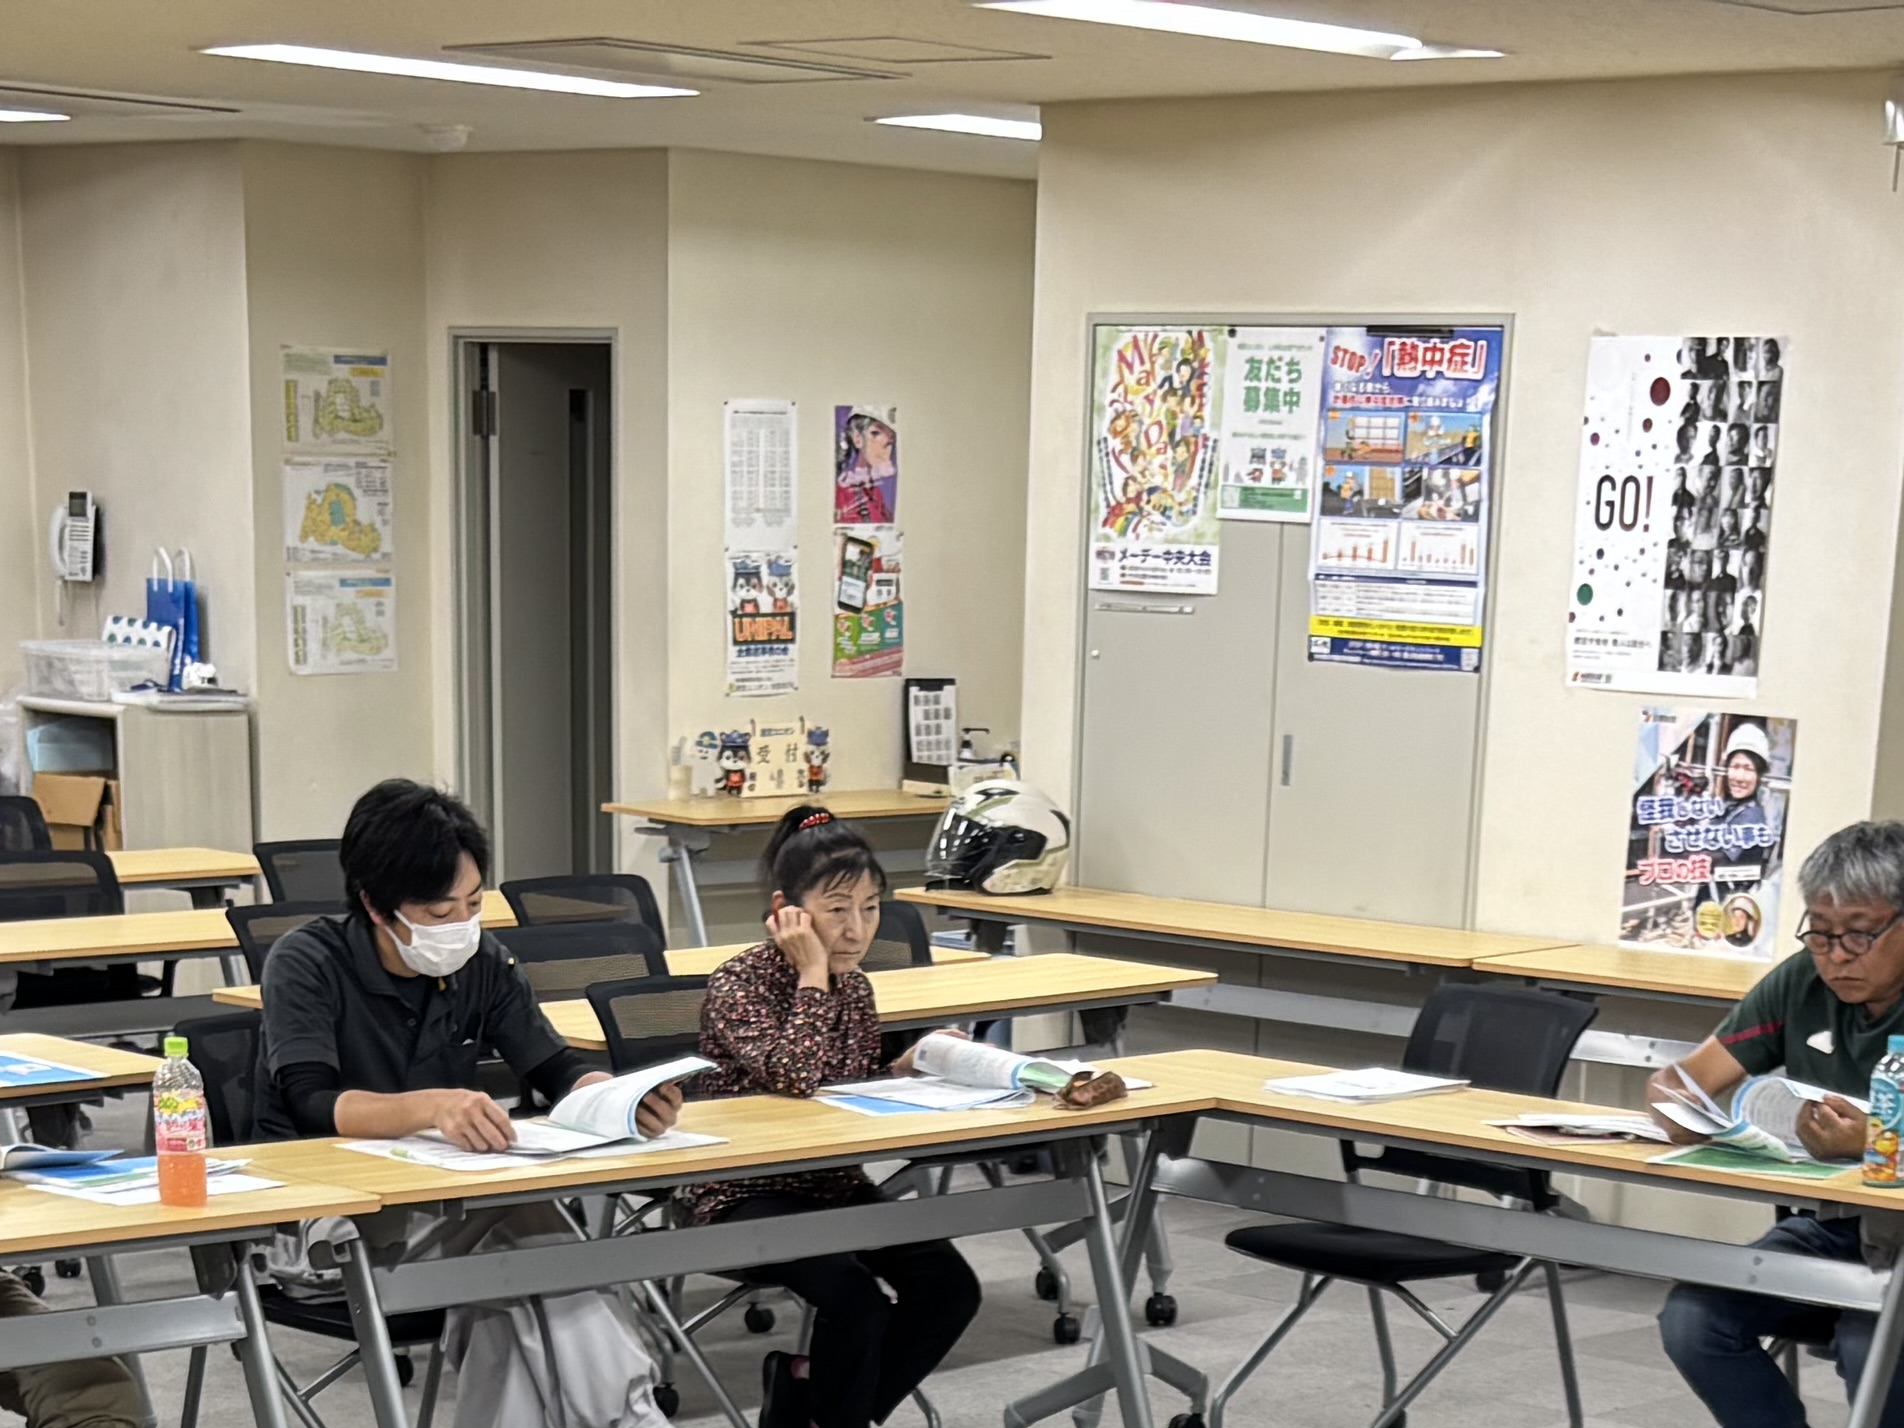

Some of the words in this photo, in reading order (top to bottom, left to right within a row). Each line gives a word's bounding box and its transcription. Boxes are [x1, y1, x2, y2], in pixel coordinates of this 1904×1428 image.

[1243, 356, 1303, 384] 友だち
[1243, 386, 1301, 413] 募集中
[1594, 474, 1655, 533] GO!
[1118, 547, 1213, 567] メーデー中央大会
